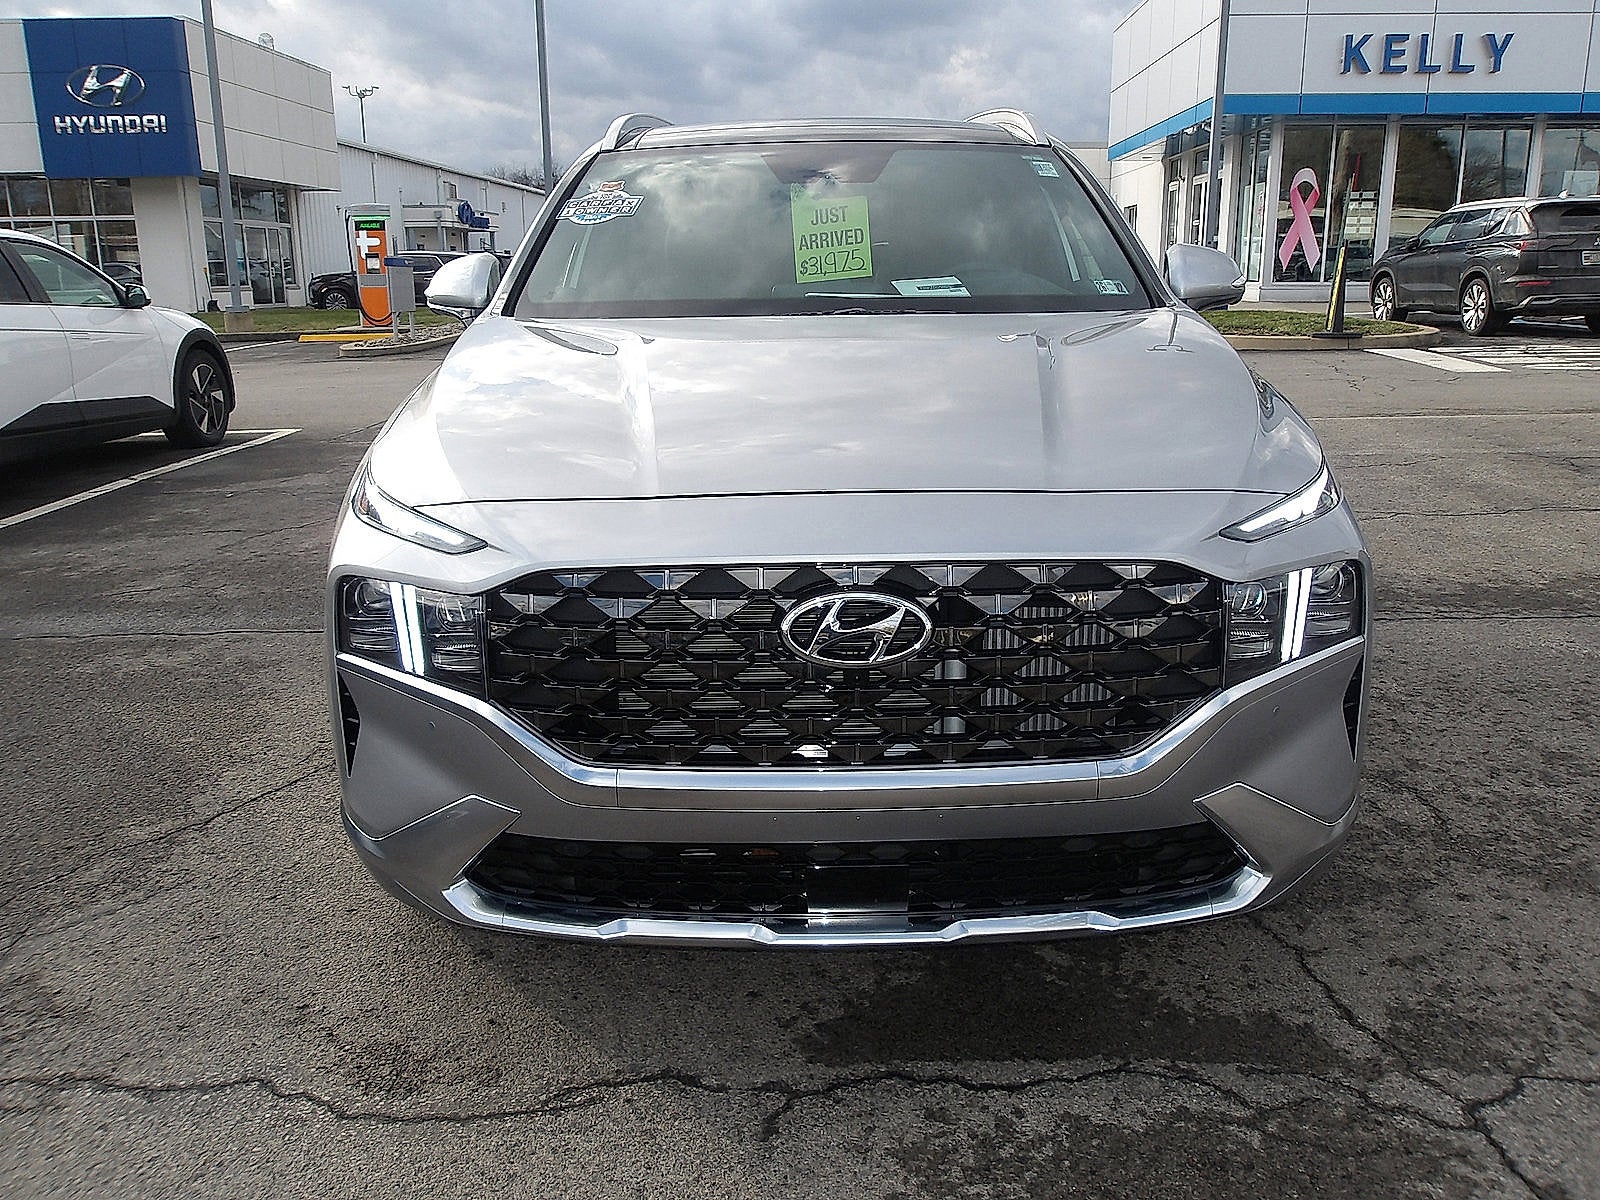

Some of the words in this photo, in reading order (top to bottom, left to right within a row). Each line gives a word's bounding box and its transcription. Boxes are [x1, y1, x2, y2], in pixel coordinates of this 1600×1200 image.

[1340, 32, 1516, 75] KELLY
[53, 114, 168, 134] HYUNDAI
[568, 199, 637, 208] CARFAX
[574, 205, 633, 215] OWNER
[811, 205, 848, 226] JUST
[799, 228, 864, 251] ARRIVED
[799, 248, 868, 277] $31,975
